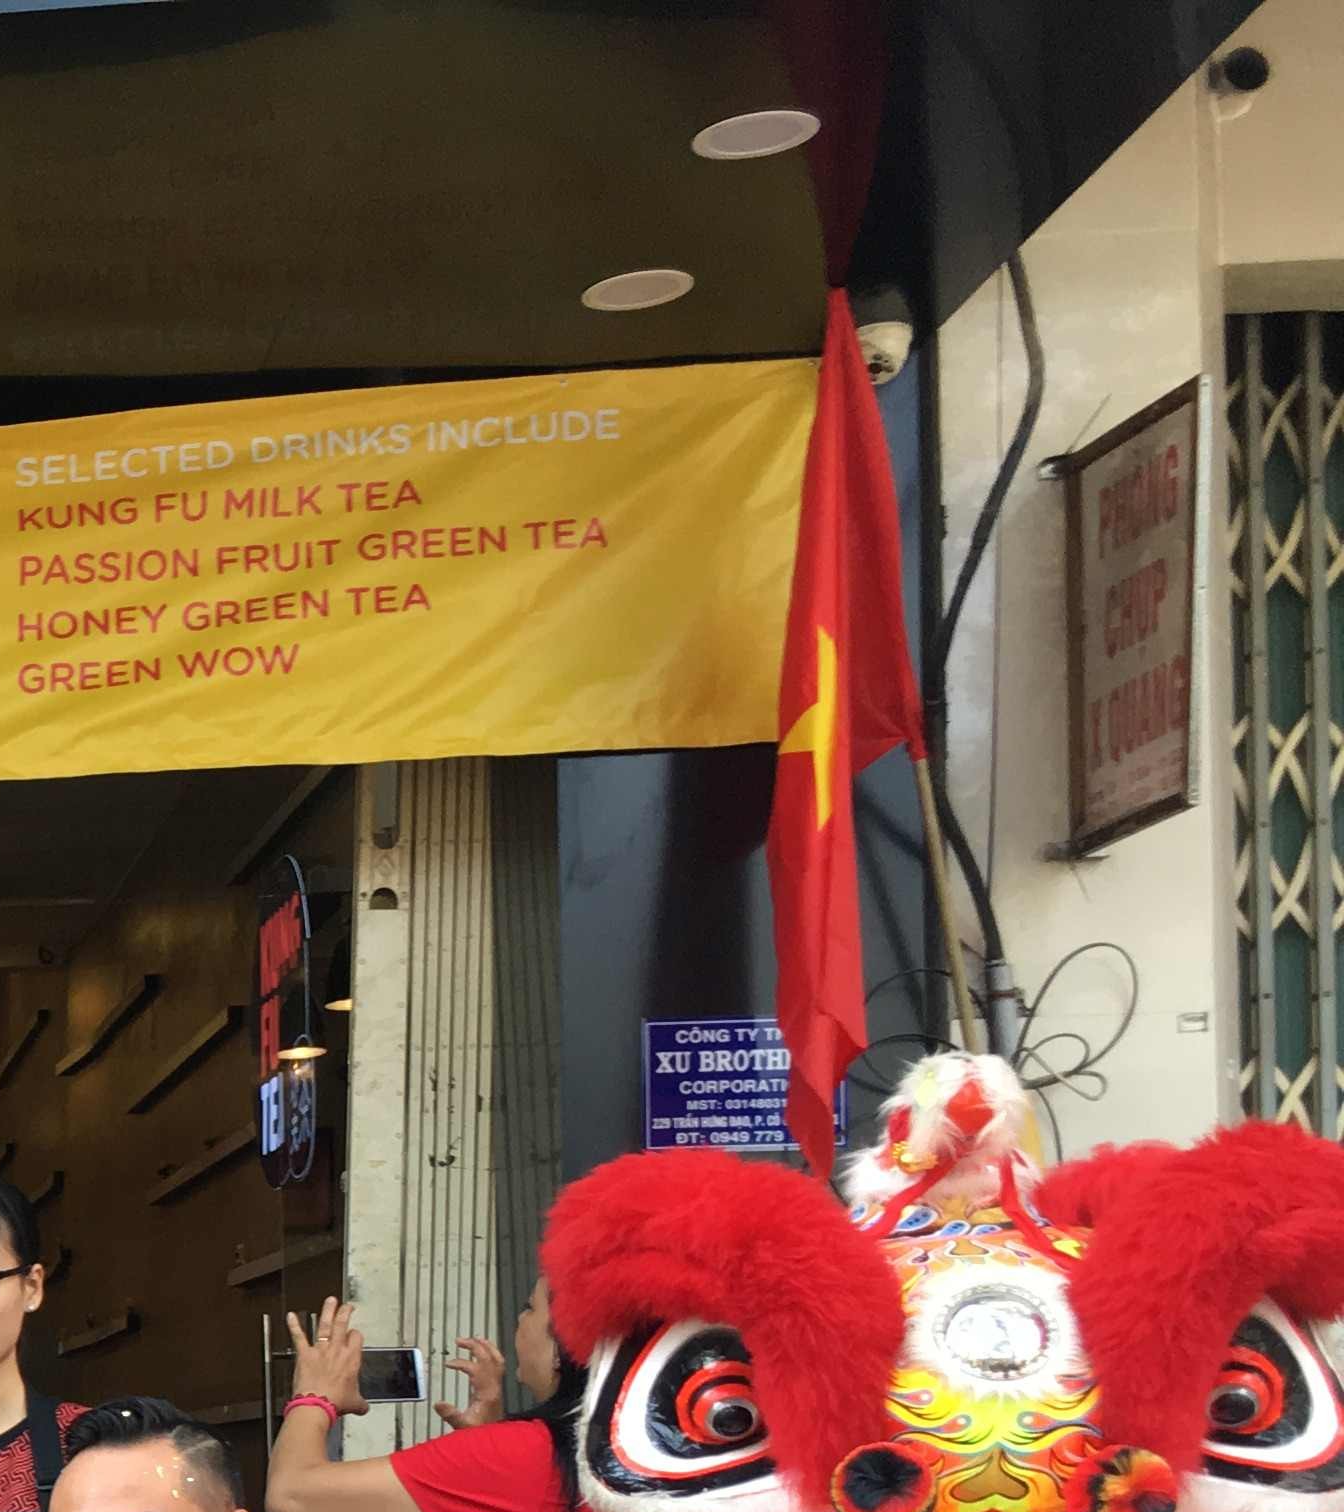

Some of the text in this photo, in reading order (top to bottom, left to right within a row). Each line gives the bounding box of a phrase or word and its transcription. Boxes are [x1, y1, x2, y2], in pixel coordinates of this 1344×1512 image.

[15, 408, 622, 488] SELECTED DRINKS INCLUDE
[17, 479, 423, 532] KUNG FU MILK TEA
[18, 516, 609, 587] PASSION FRUIT GREEN TEA
[17, 583, 432, 643] HONEY GREEN TEA
[17, 643, 300, 695] GREEN WOW
[675, 1027, 731, 1043] CÔNG
[735, 1028, 757, 1042] TY
[655, 1051, 693, 1074] XU
[679, 1078, 789, 1095] CORPORATI
